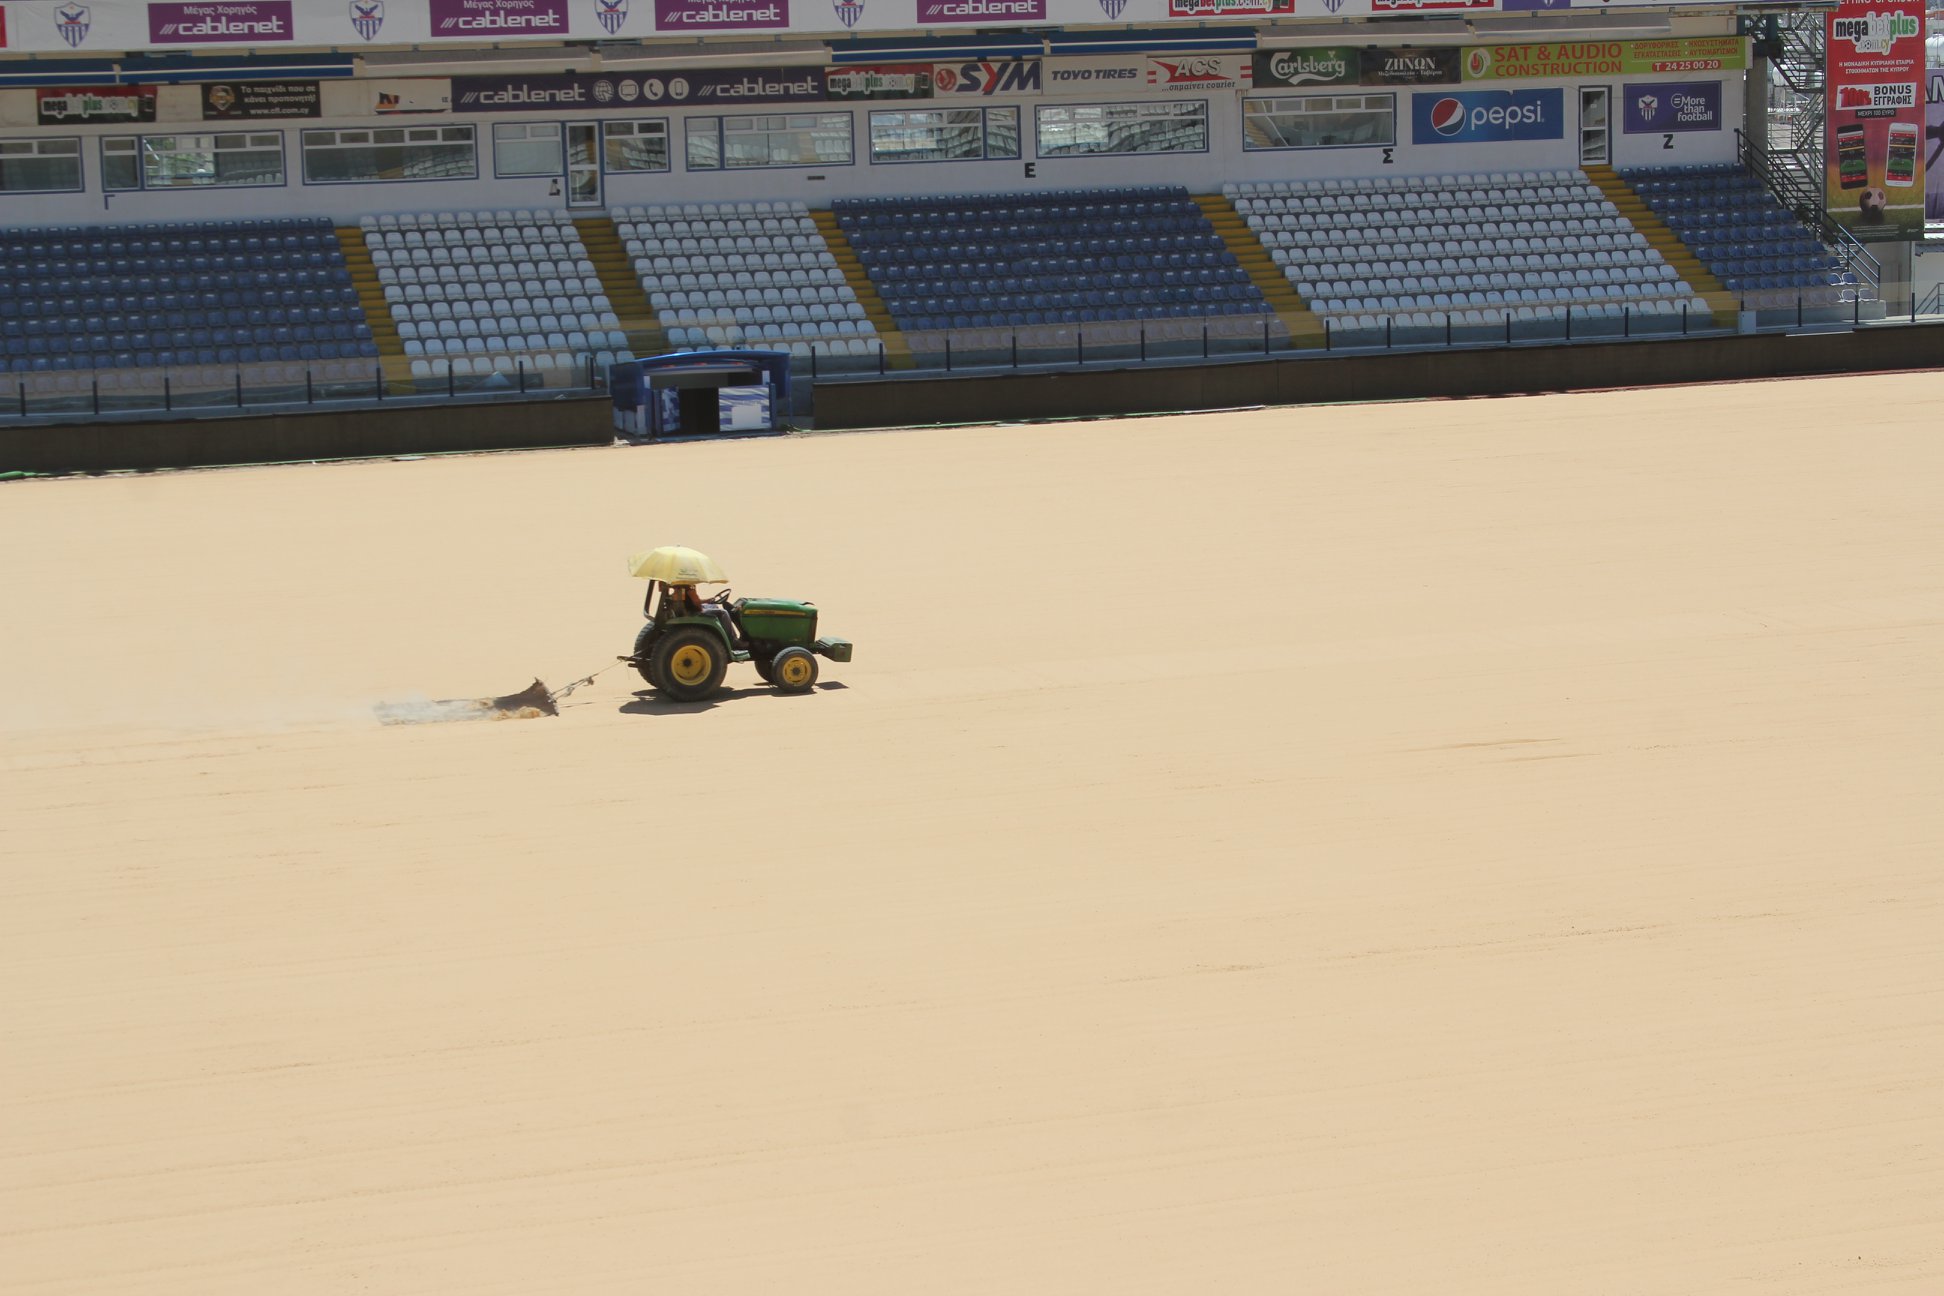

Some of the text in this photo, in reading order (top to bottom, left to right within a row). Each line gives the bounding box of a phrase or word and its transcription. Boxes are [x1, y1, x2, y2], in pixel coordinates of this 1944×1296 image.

[184, 4, 257, 16] Μέγας Χορηγός
[682, 4, 780, 23] cablenet
[943, 0, 1038, 15] cablenet
[178, 16, 284, 35] cablenet
[458, 9, 560, 29] cablenet
[1494, 43, 1622, 62] SAT & AUDIO
[1174, 57, 1222, 78] ACS
[1270, 52, 1345, 80] Carlsberg
[1495, 61, 1622, 77] CONSTRUCTION
[1665, 62, 1678, 71] 24
[1679, 61, 1691, 70] 25
[1692, 61, 1705, 70] 00
[1706, 60, 1719, 69] 20
[955, 61, 1041, 96] SYM
[1051, 68, 1137, 81] TOYO TIRES
[240, 86, 252, 94] Το
[715, 76, 819, 97] cablenet
[1206, 81, 1236, 90] courier
[1873, 85, 1912, 95] BONUS
[479, 83, 586, 104] cablenet
[1681, 96, 1706, 105] More
[1873, 95, 1912, 106] ΕΓΓΡΑΦΗΣ
[1471, 100, 1542, 131] pepsi
[1677, 110, 1713, 122] football
[1684, 104, 1705, 113] than
